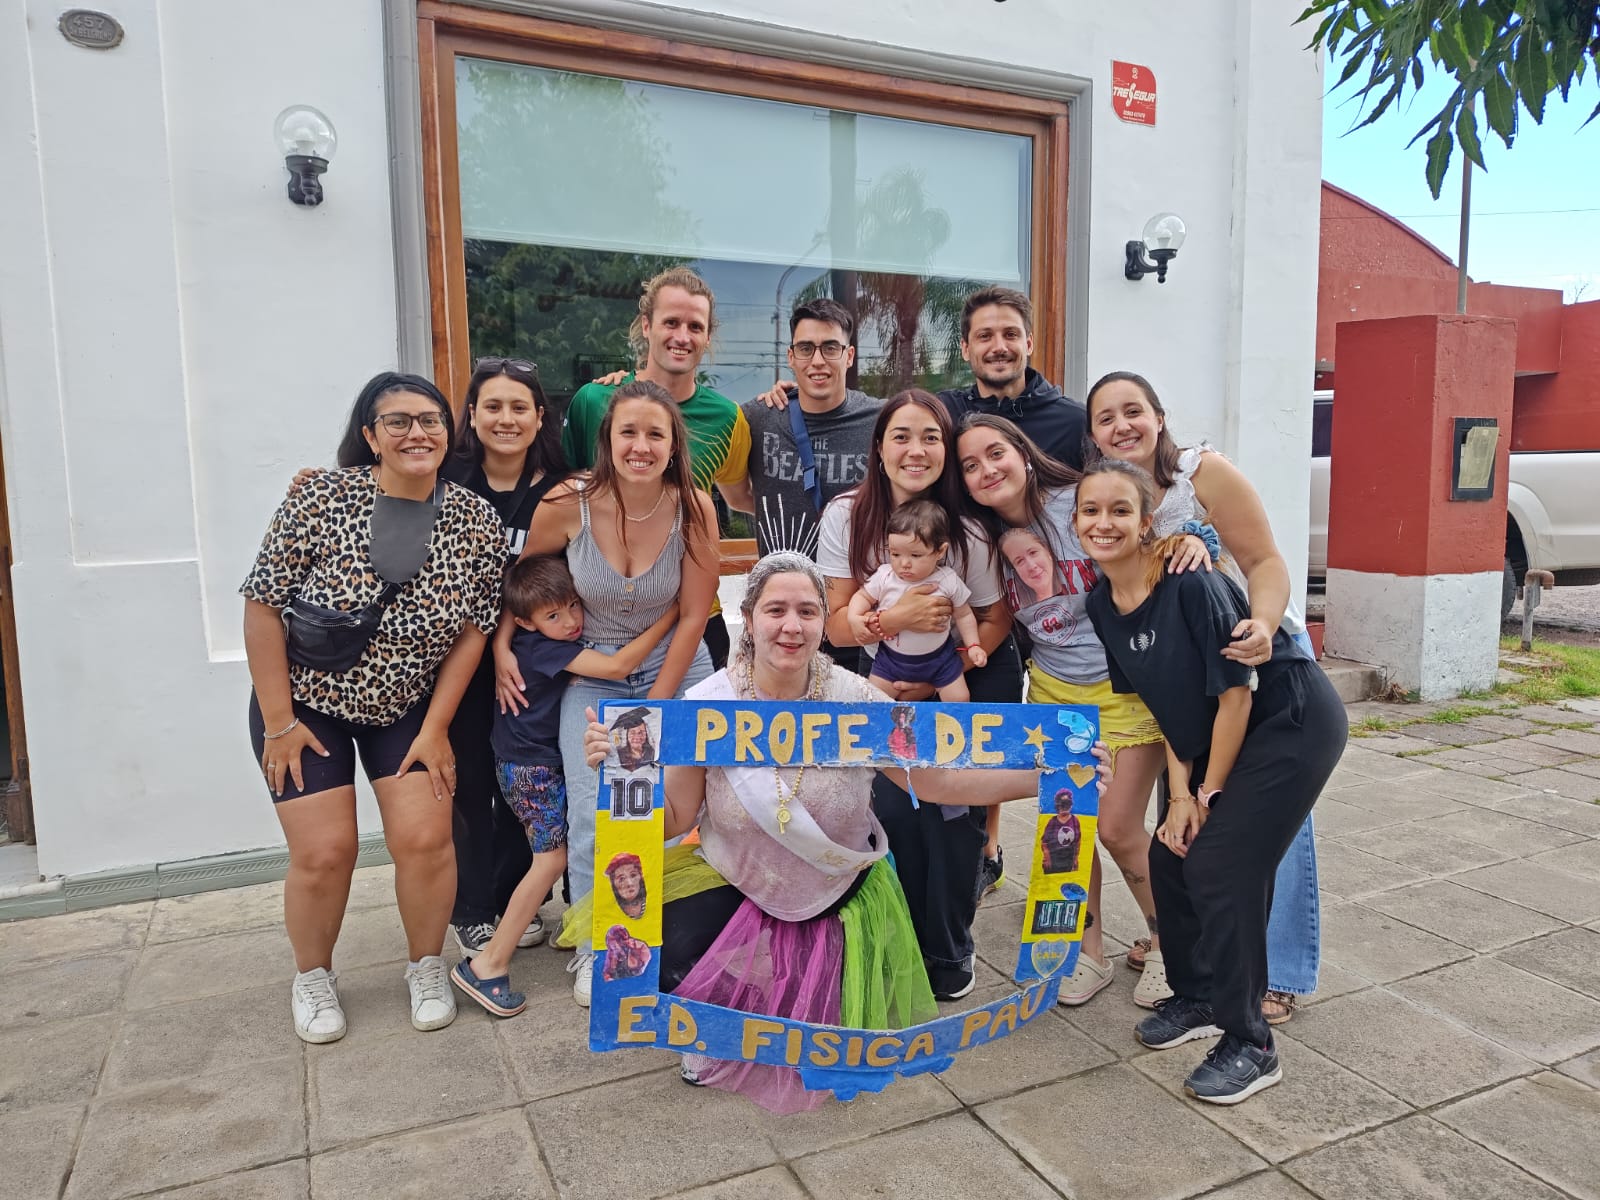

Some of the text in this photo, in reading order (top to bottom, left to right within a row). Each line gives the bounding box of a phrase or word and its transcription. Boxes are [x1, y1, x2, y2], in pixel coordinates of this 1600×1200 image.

[73, 15, 105, 28] 457
[812, 438, 829, 450] HE
[695, 708, 1004, 765] PROFE DE
[611, 778, 653, 816] 10
[617, 986, 1046, 1067] ED. FISICA PAU
